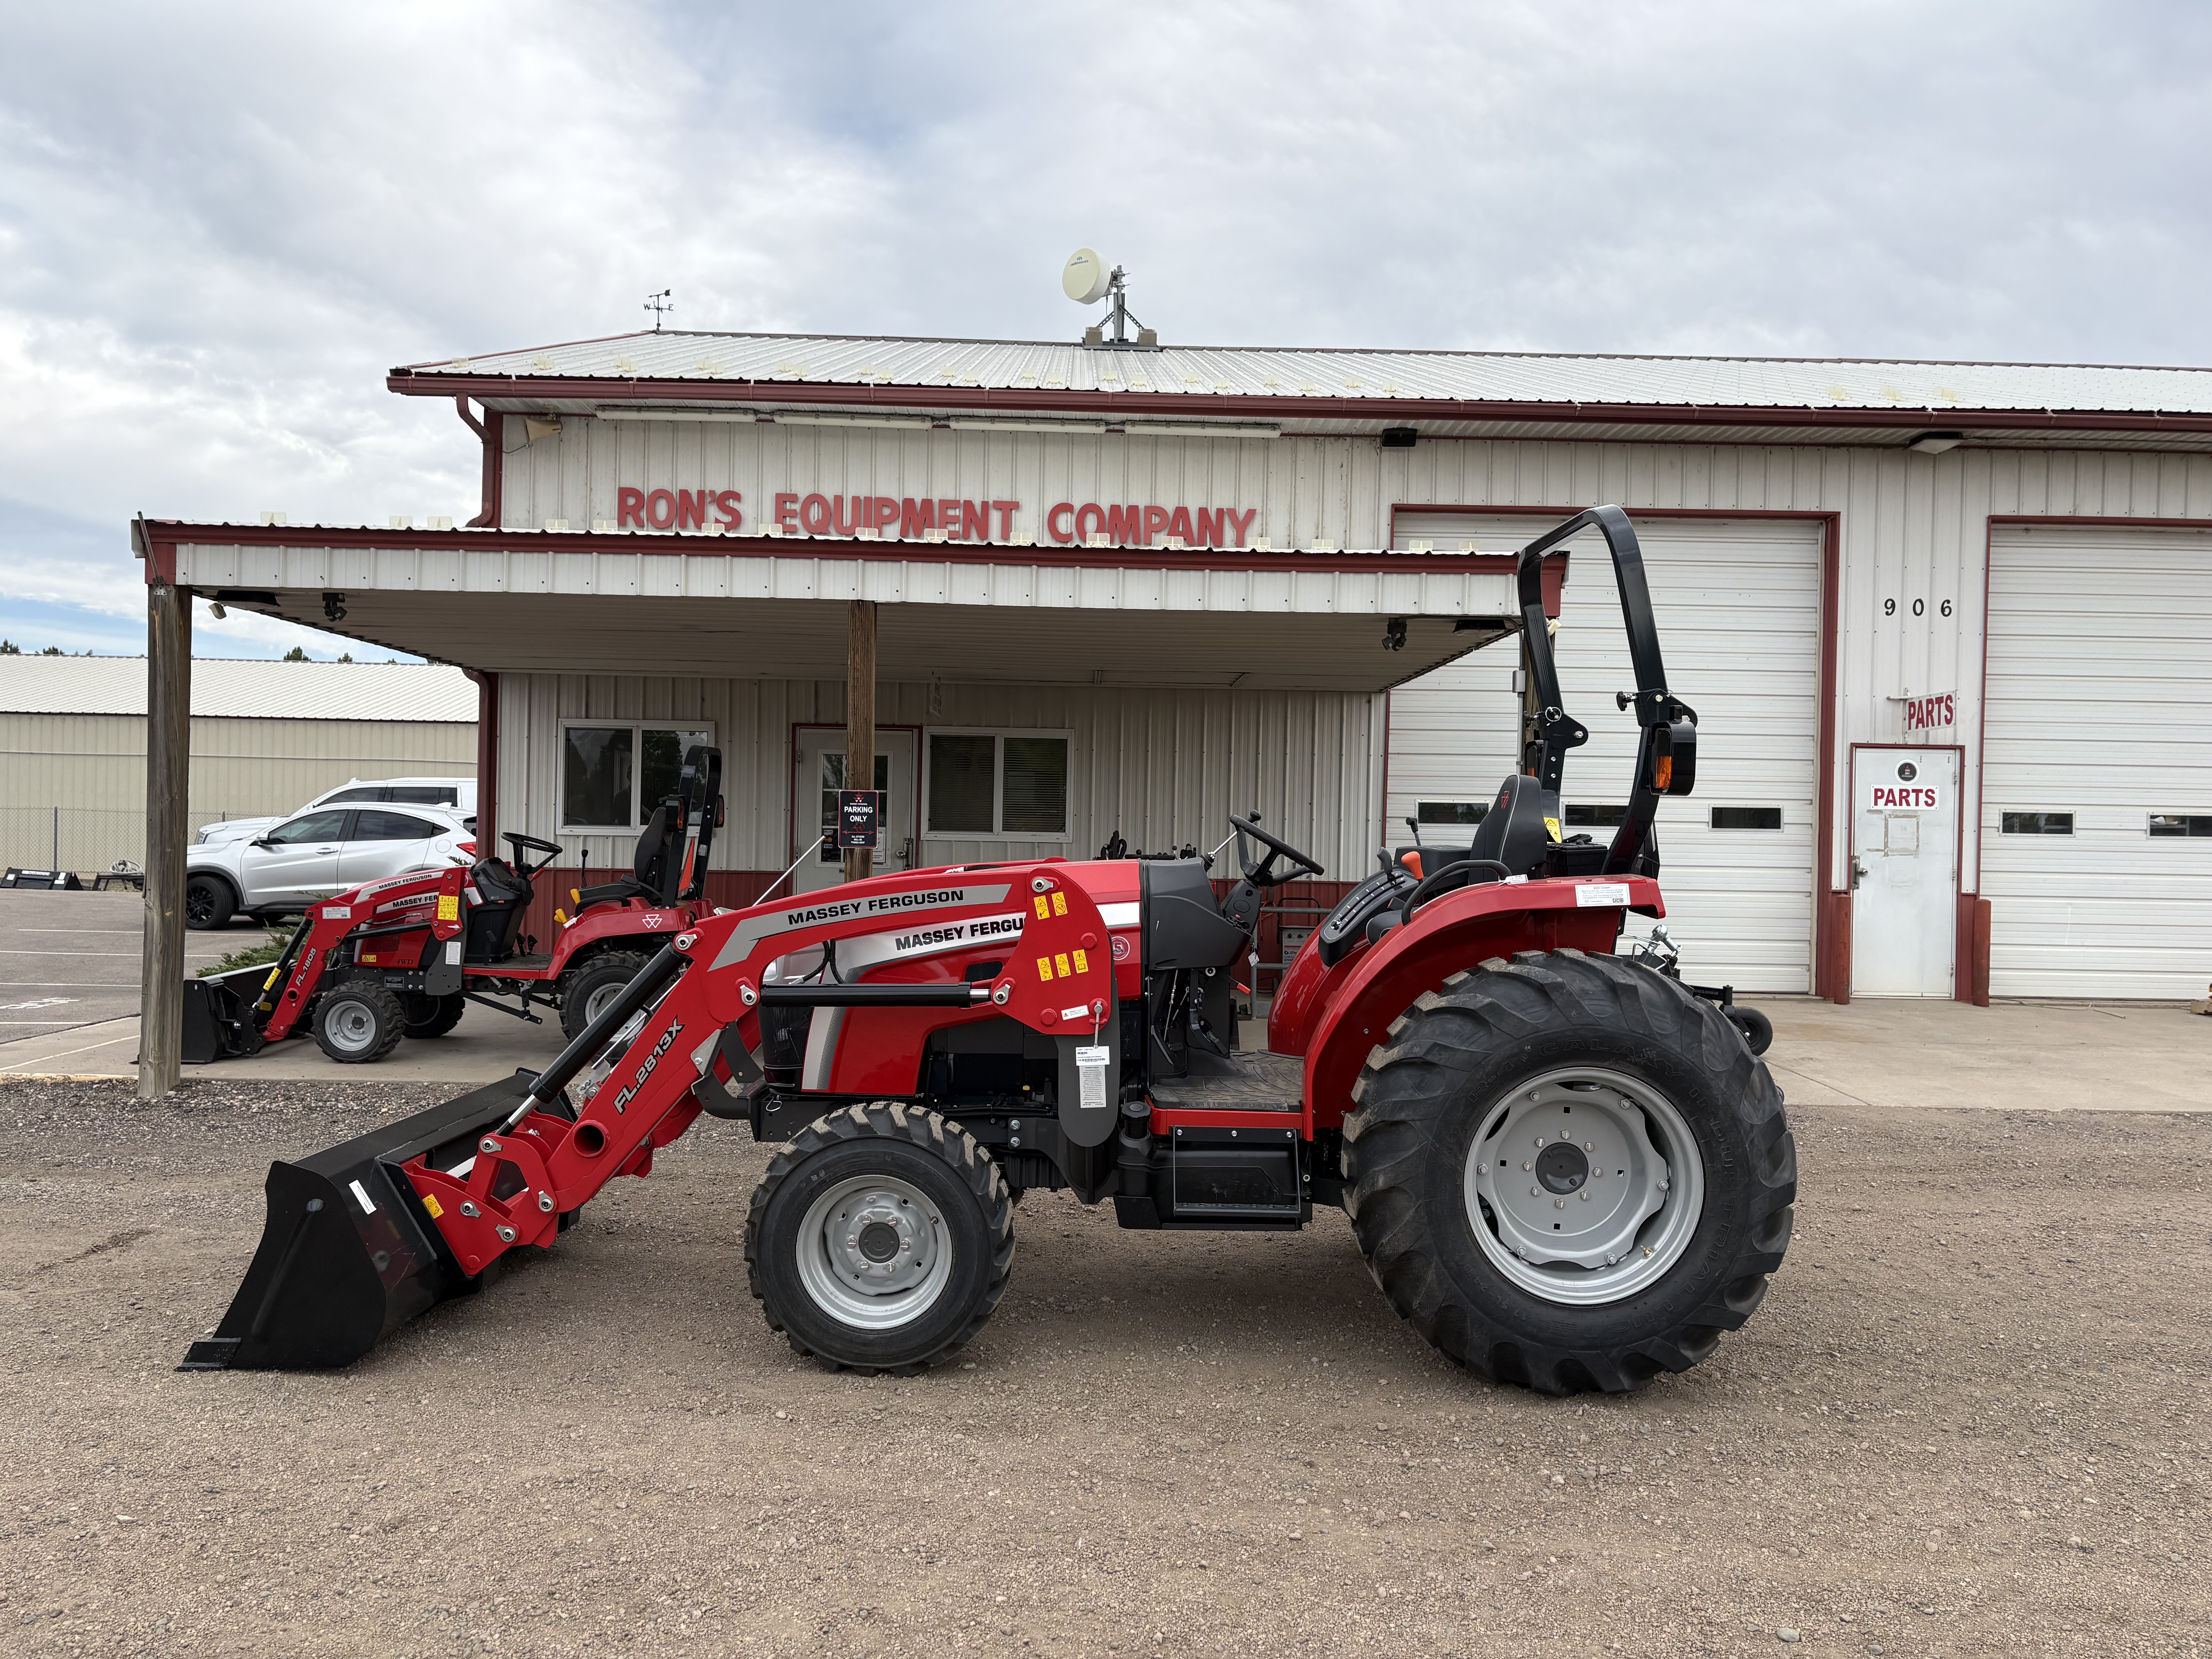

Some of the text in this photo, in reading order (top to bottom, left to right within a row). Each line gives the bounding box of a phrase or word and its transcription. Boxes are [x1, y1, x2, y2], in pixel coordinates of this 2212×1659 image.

[618, 487, 1257, 547] RON'S EQUIPMENT COMPANY
[1908, 694, 1953, 730] PARTS
[1874, 788, 1936, 807] PARTS
[379, 874, 432, 889] MASSEY FERGUSON
[393, 897, 422, 907] MASSEY
[788, 890, 963, 925] MASSEY FERGUSON
[895, 917, 1026, 951] MASSEY FERGU
[613, 1016, 684, 1114] FL.2813X
[1538, 1039, 1683, 1078] GALAXY
[1677, 1087, 1737, 1295] INDUSTRIAL
